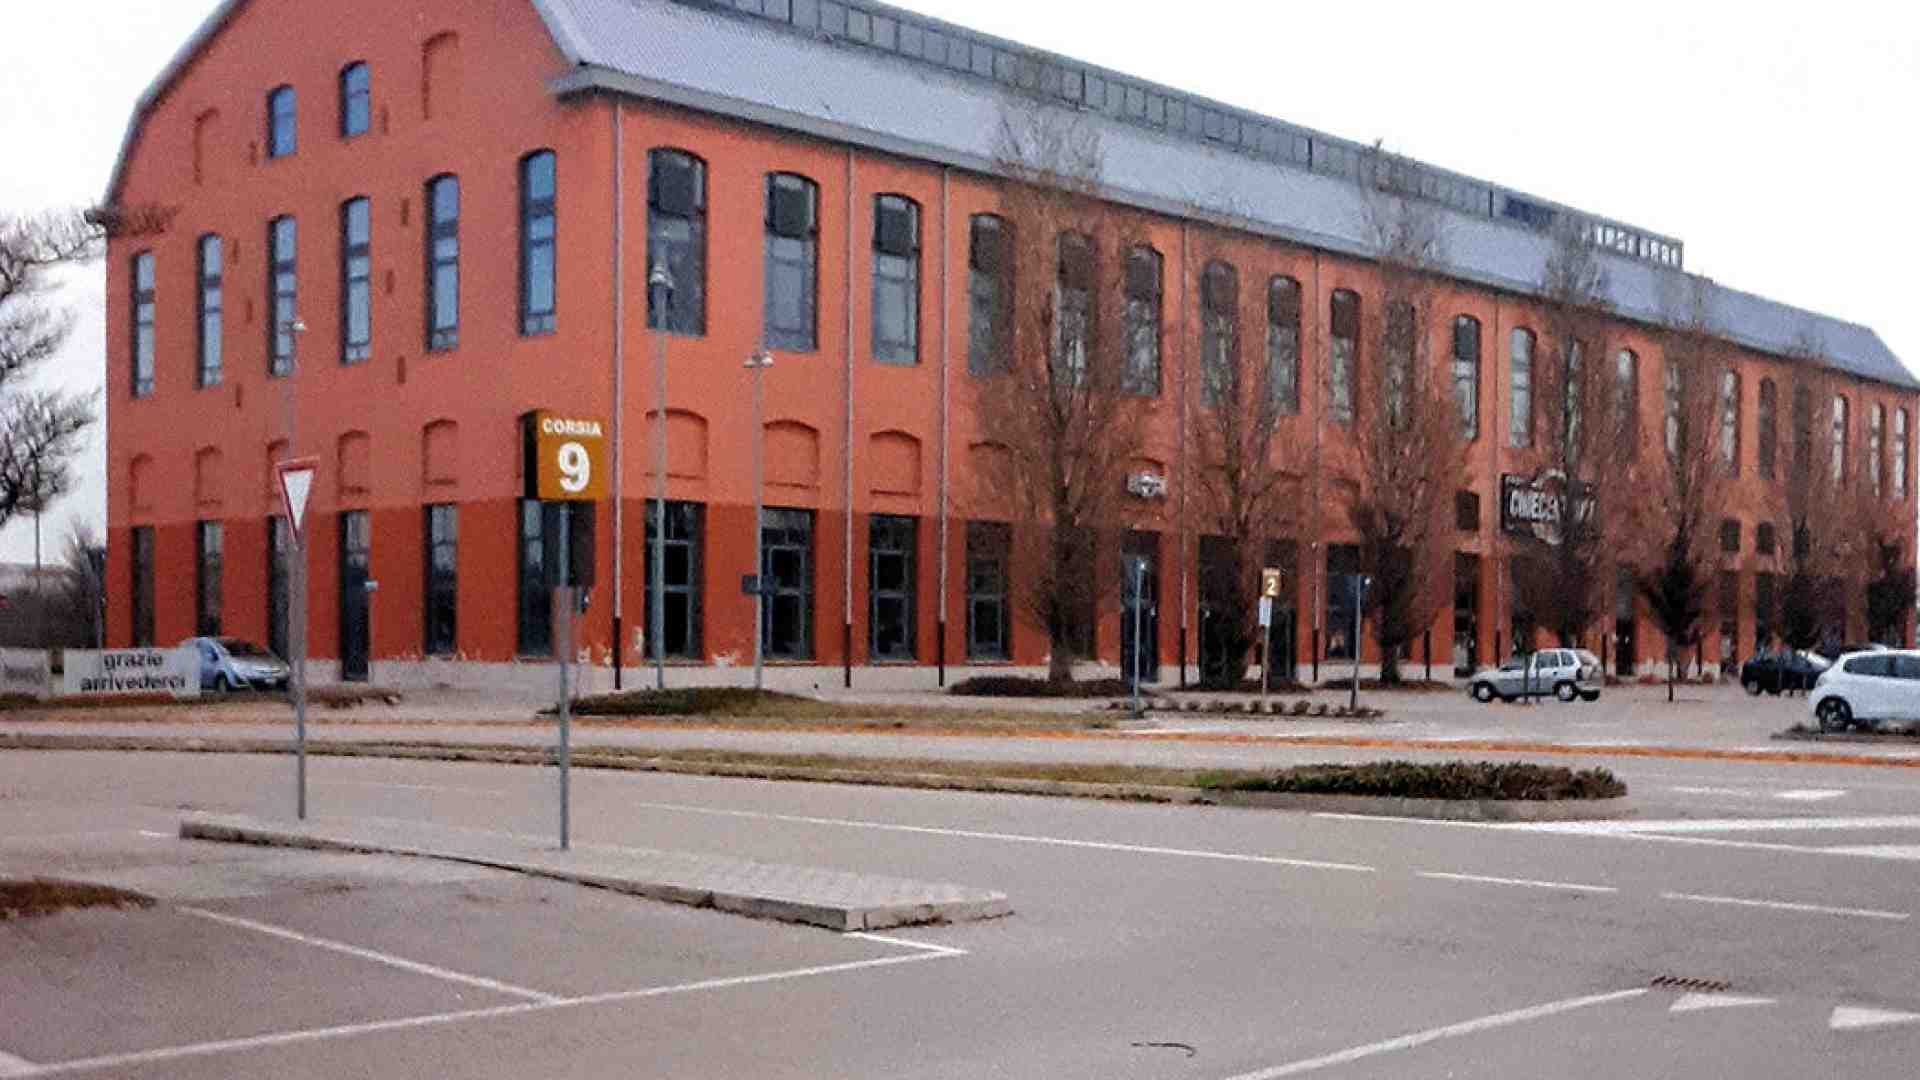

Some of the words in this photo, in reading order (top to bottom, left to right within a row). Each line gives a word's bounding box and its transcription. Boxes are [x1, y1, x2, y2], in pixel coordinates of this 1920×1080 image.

[542, 418, 603, 437] CORSIA
[558, 441, 591, 493] 9
[1266, 576, 1279, 597] 2
[103, 652, 164, 670] grazie
[79, 672, 186, 692] arrivederci
